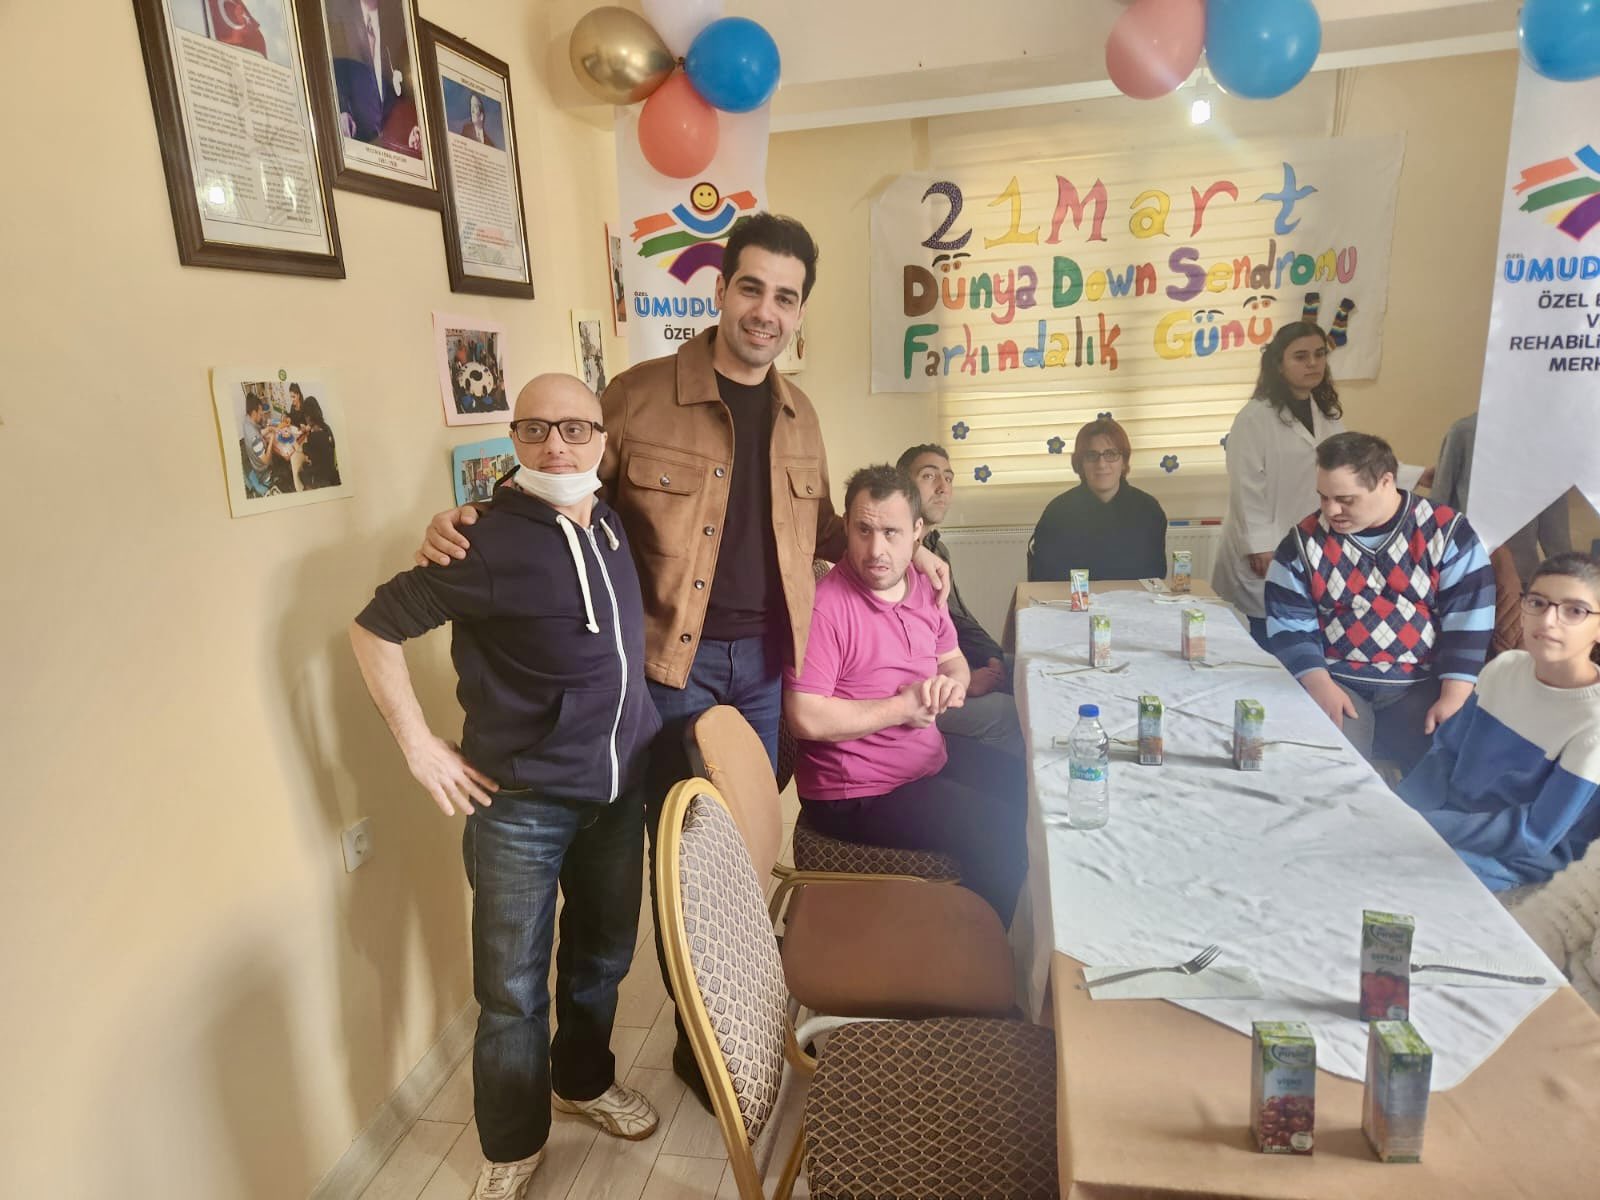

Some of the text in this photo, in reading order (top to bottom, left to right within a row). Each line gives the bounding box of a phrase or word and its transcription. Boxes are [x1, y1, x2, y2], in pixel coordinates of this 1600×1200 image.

[921, 162, 1319, 250] 21 Mart
[904, 238, 1358, 325] Dünya Down Sendromu
[1538, 290, 1589, 309] ÖZEL
[904, 297, 1273, 380] Farkındalık Günü
